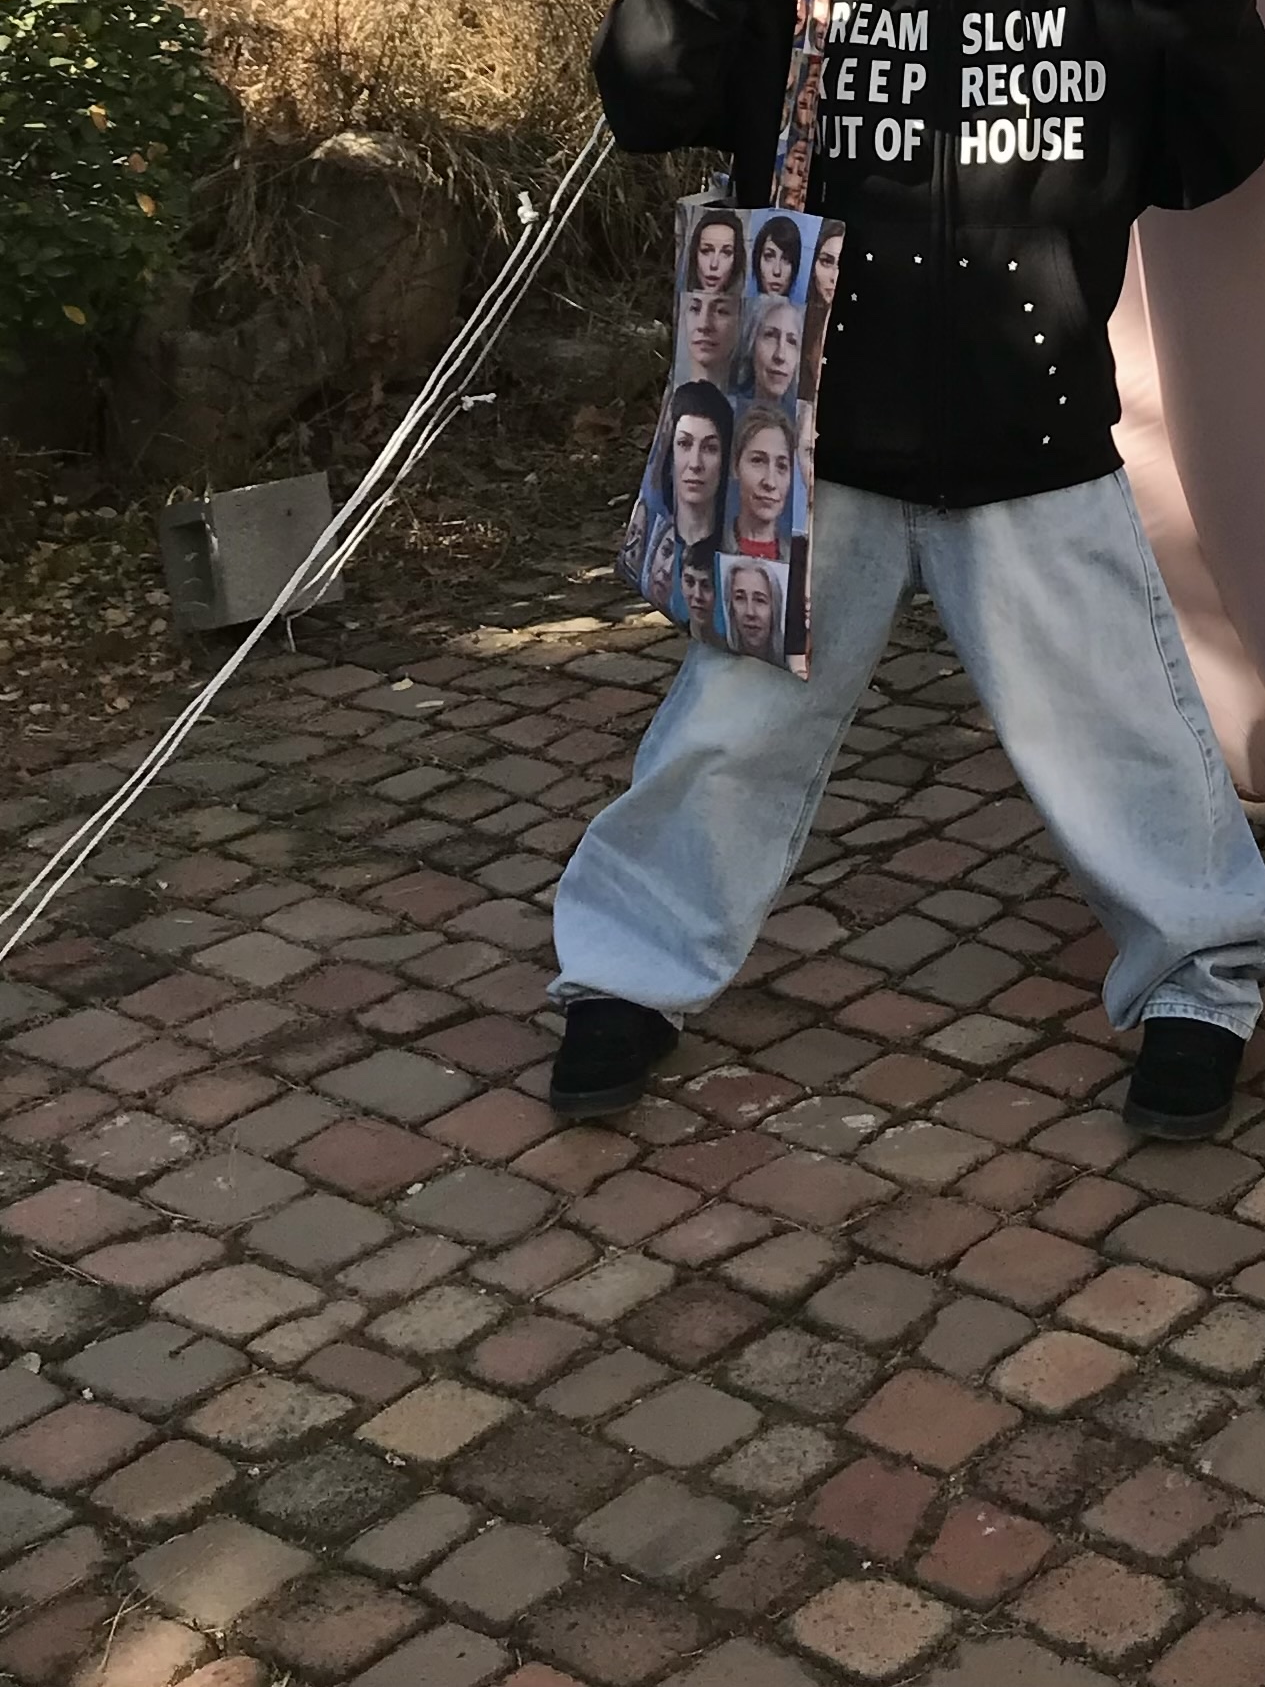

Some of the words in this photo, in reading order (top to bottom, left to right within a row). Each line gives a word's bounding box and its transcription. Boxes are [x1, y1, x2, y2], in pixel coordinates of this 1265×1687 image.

[828, 1, 929, 52] REAM
[961, 6, 1067, 55] SLOW
[961, 60, 1107, 109] RECORD
[816, 115, 864, 160] UT
[874, 117, 926, 162] OF
[959, 116, 1085, 165] HOUSE
